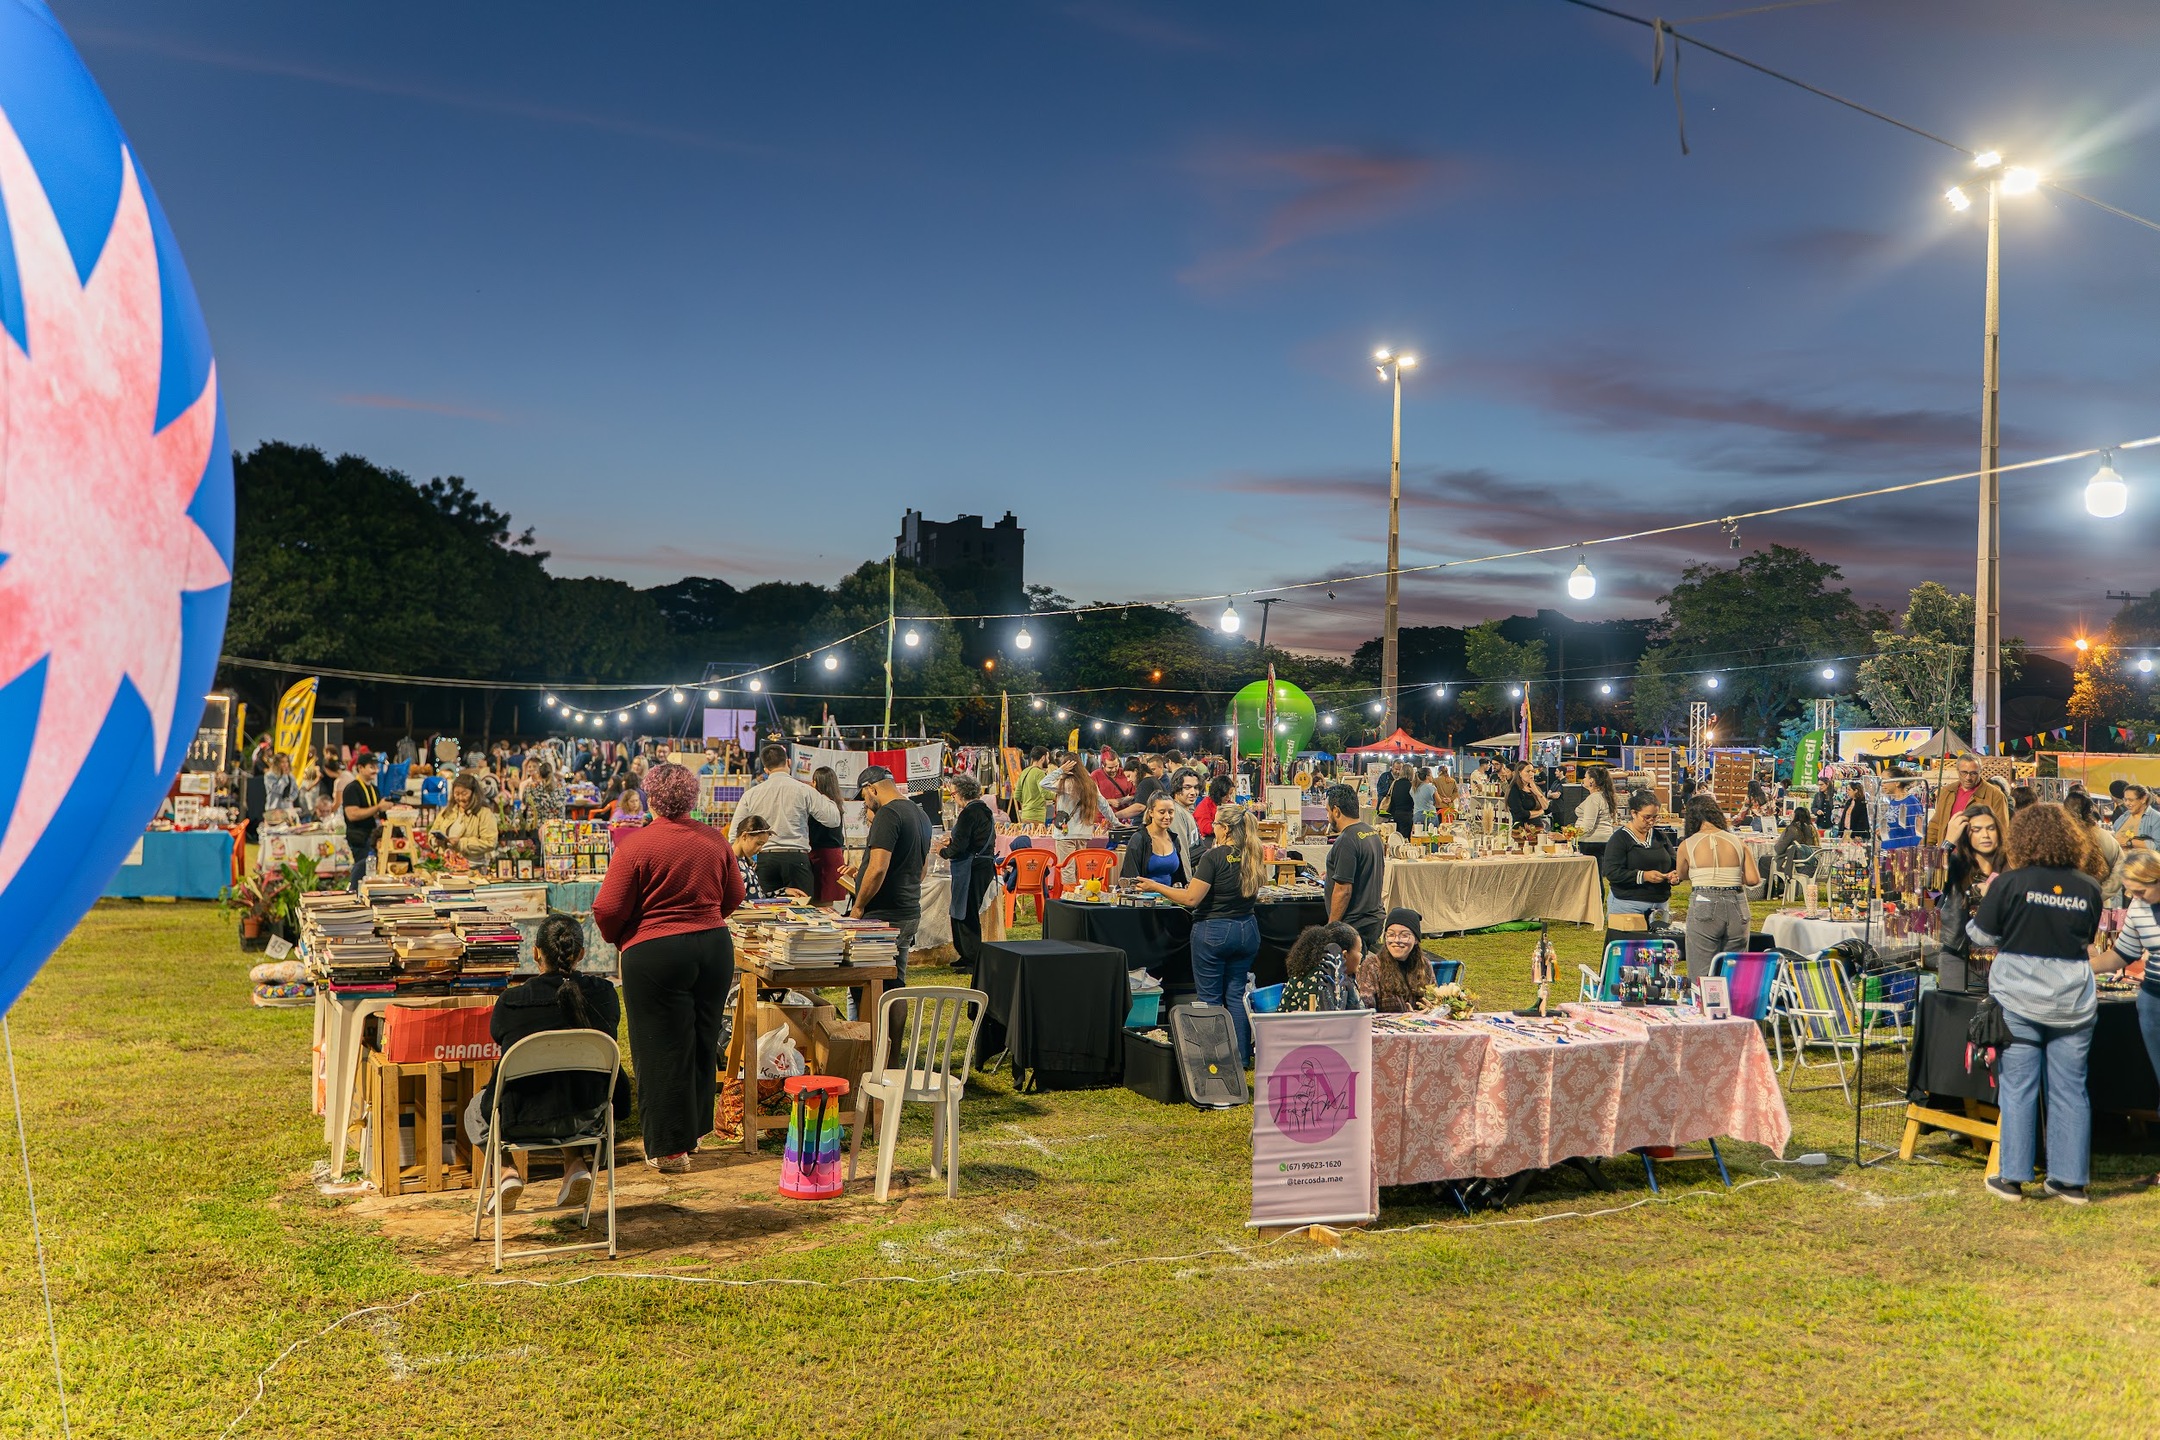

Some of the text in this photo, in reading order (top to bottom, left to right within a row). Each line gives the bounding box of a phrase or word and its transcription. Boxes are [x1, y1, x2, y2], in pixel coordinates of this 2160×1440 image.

[2026, 890, 2088, 912] PRODUÇÃO
[434, 1042, 502, 1060] CHAMEX
[1286, 1160, 1342, 1171] (67) 99623-1620
[1287, 1175, 1344, 1186] @tercosda.mae
